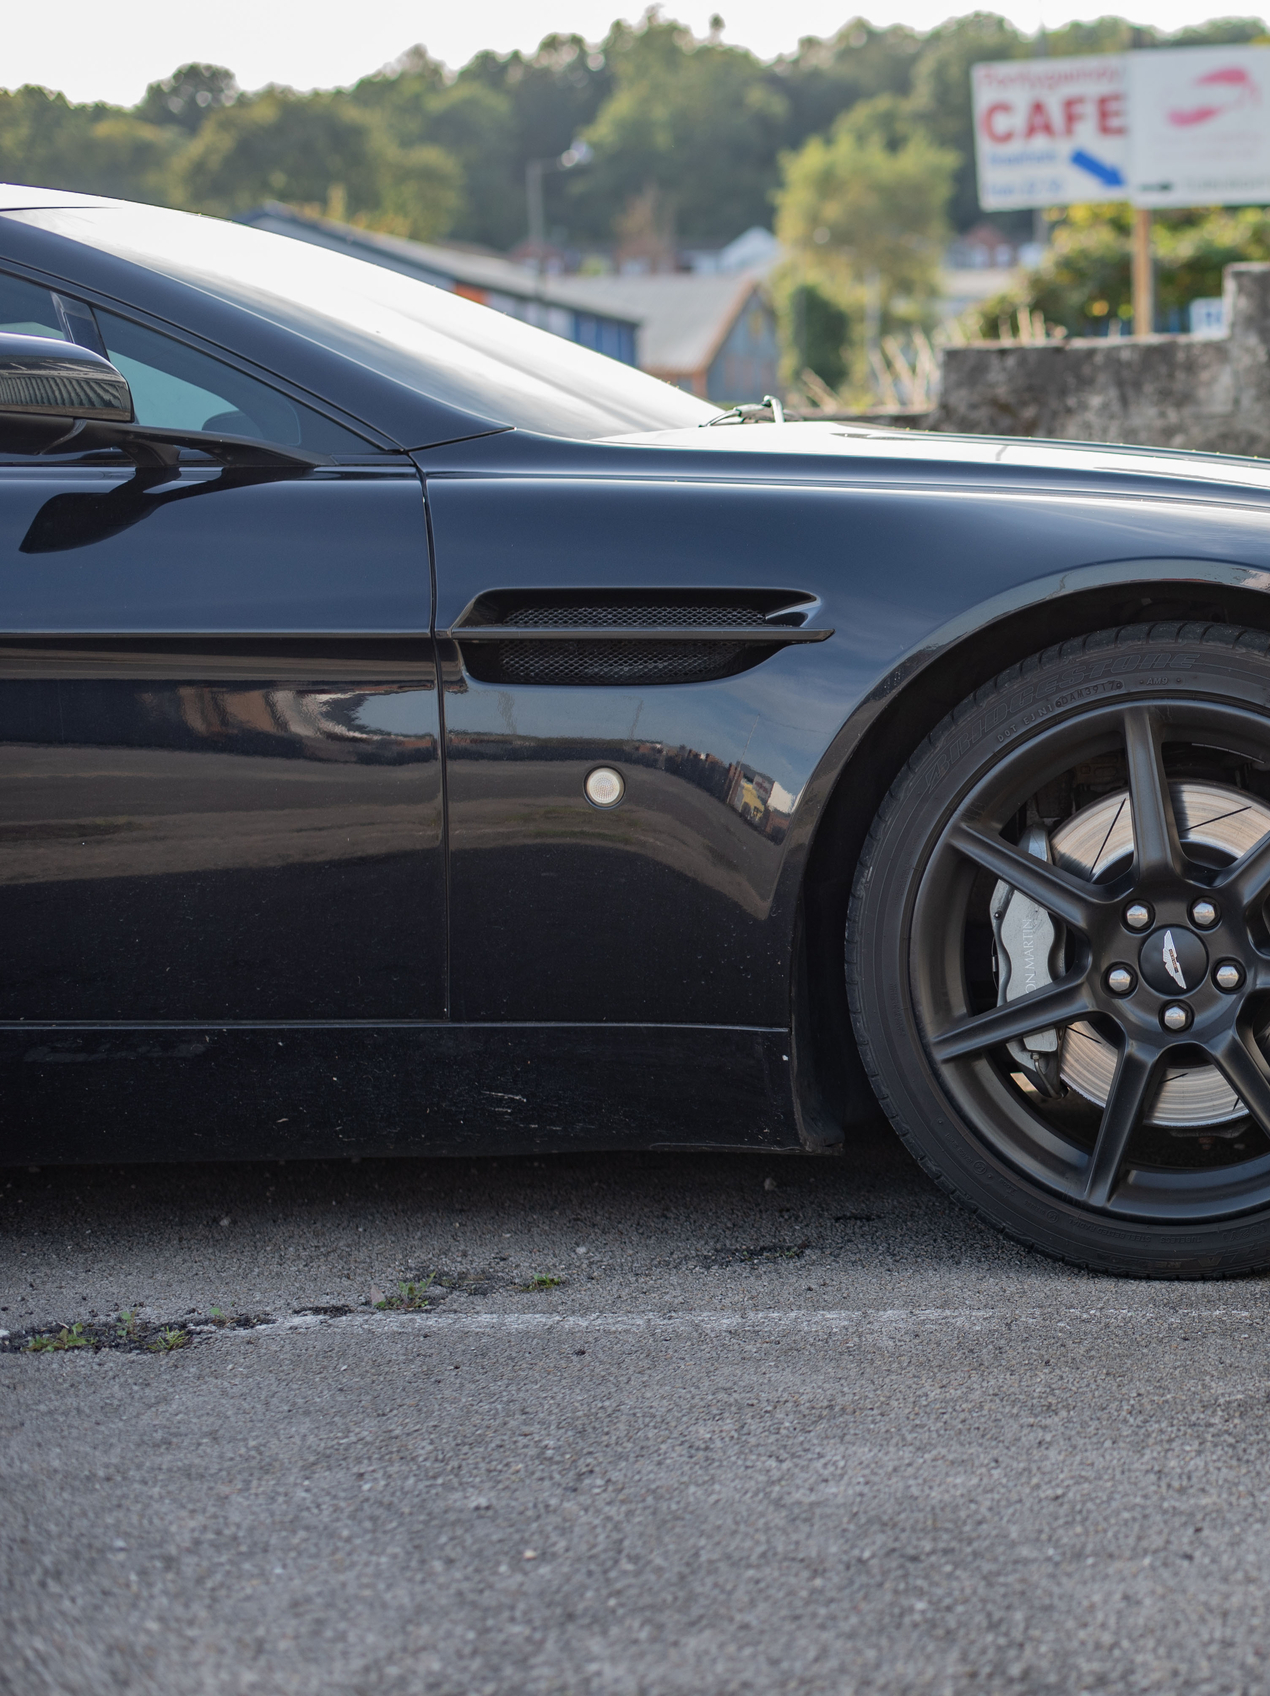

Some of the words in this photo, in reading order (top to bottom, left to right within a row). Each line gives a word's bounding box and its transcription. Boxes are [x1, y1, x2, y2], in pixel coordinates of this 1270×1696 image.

[982, 93, 1128, 143] CAFE
[1146, 676, 1168, 685] AM9
[924, 653, 1201, 793] BRIDGESTONE
[1022, 917, 1035, 969] MARTIN
